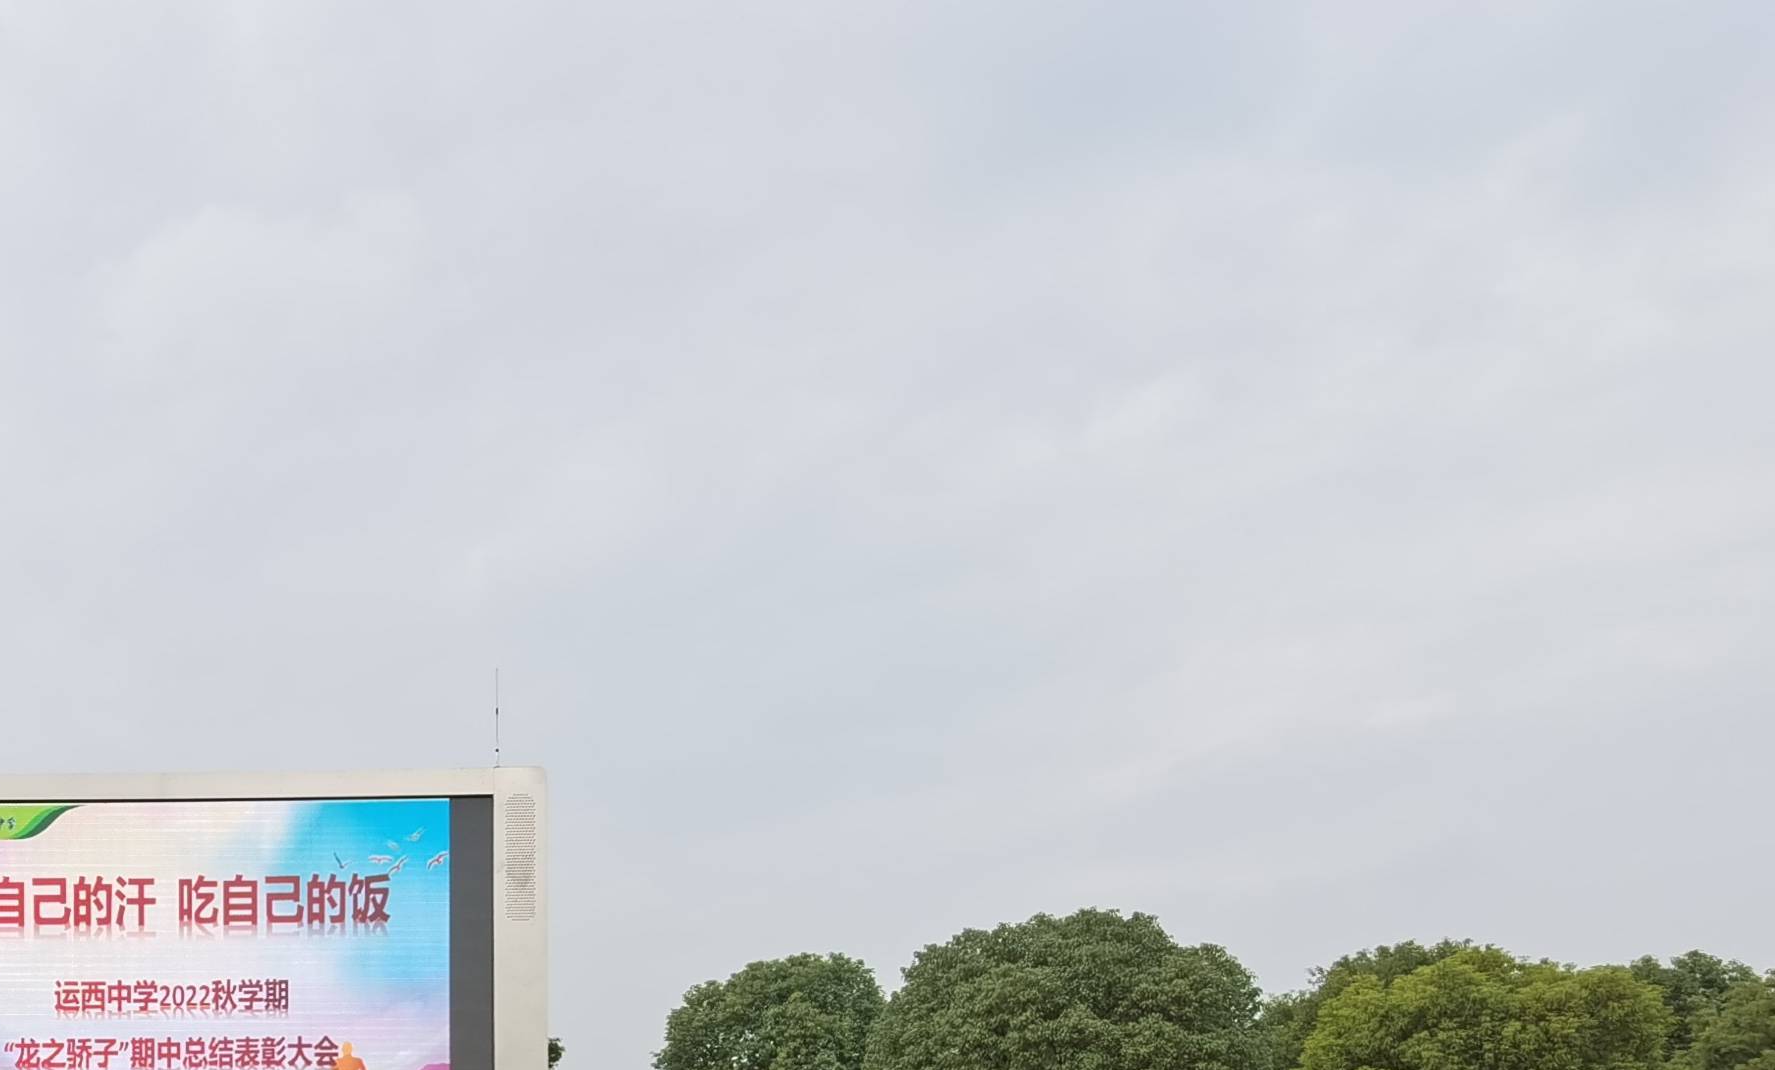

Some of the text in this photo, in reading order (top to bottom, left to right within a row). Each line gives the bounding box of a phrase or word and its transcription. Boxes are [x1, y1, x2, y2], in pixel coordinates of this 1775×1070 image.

[177, 873, 391, 927] 吃自己的饭
[53, 978, 290, 1013] 运西中学2022秋学期
